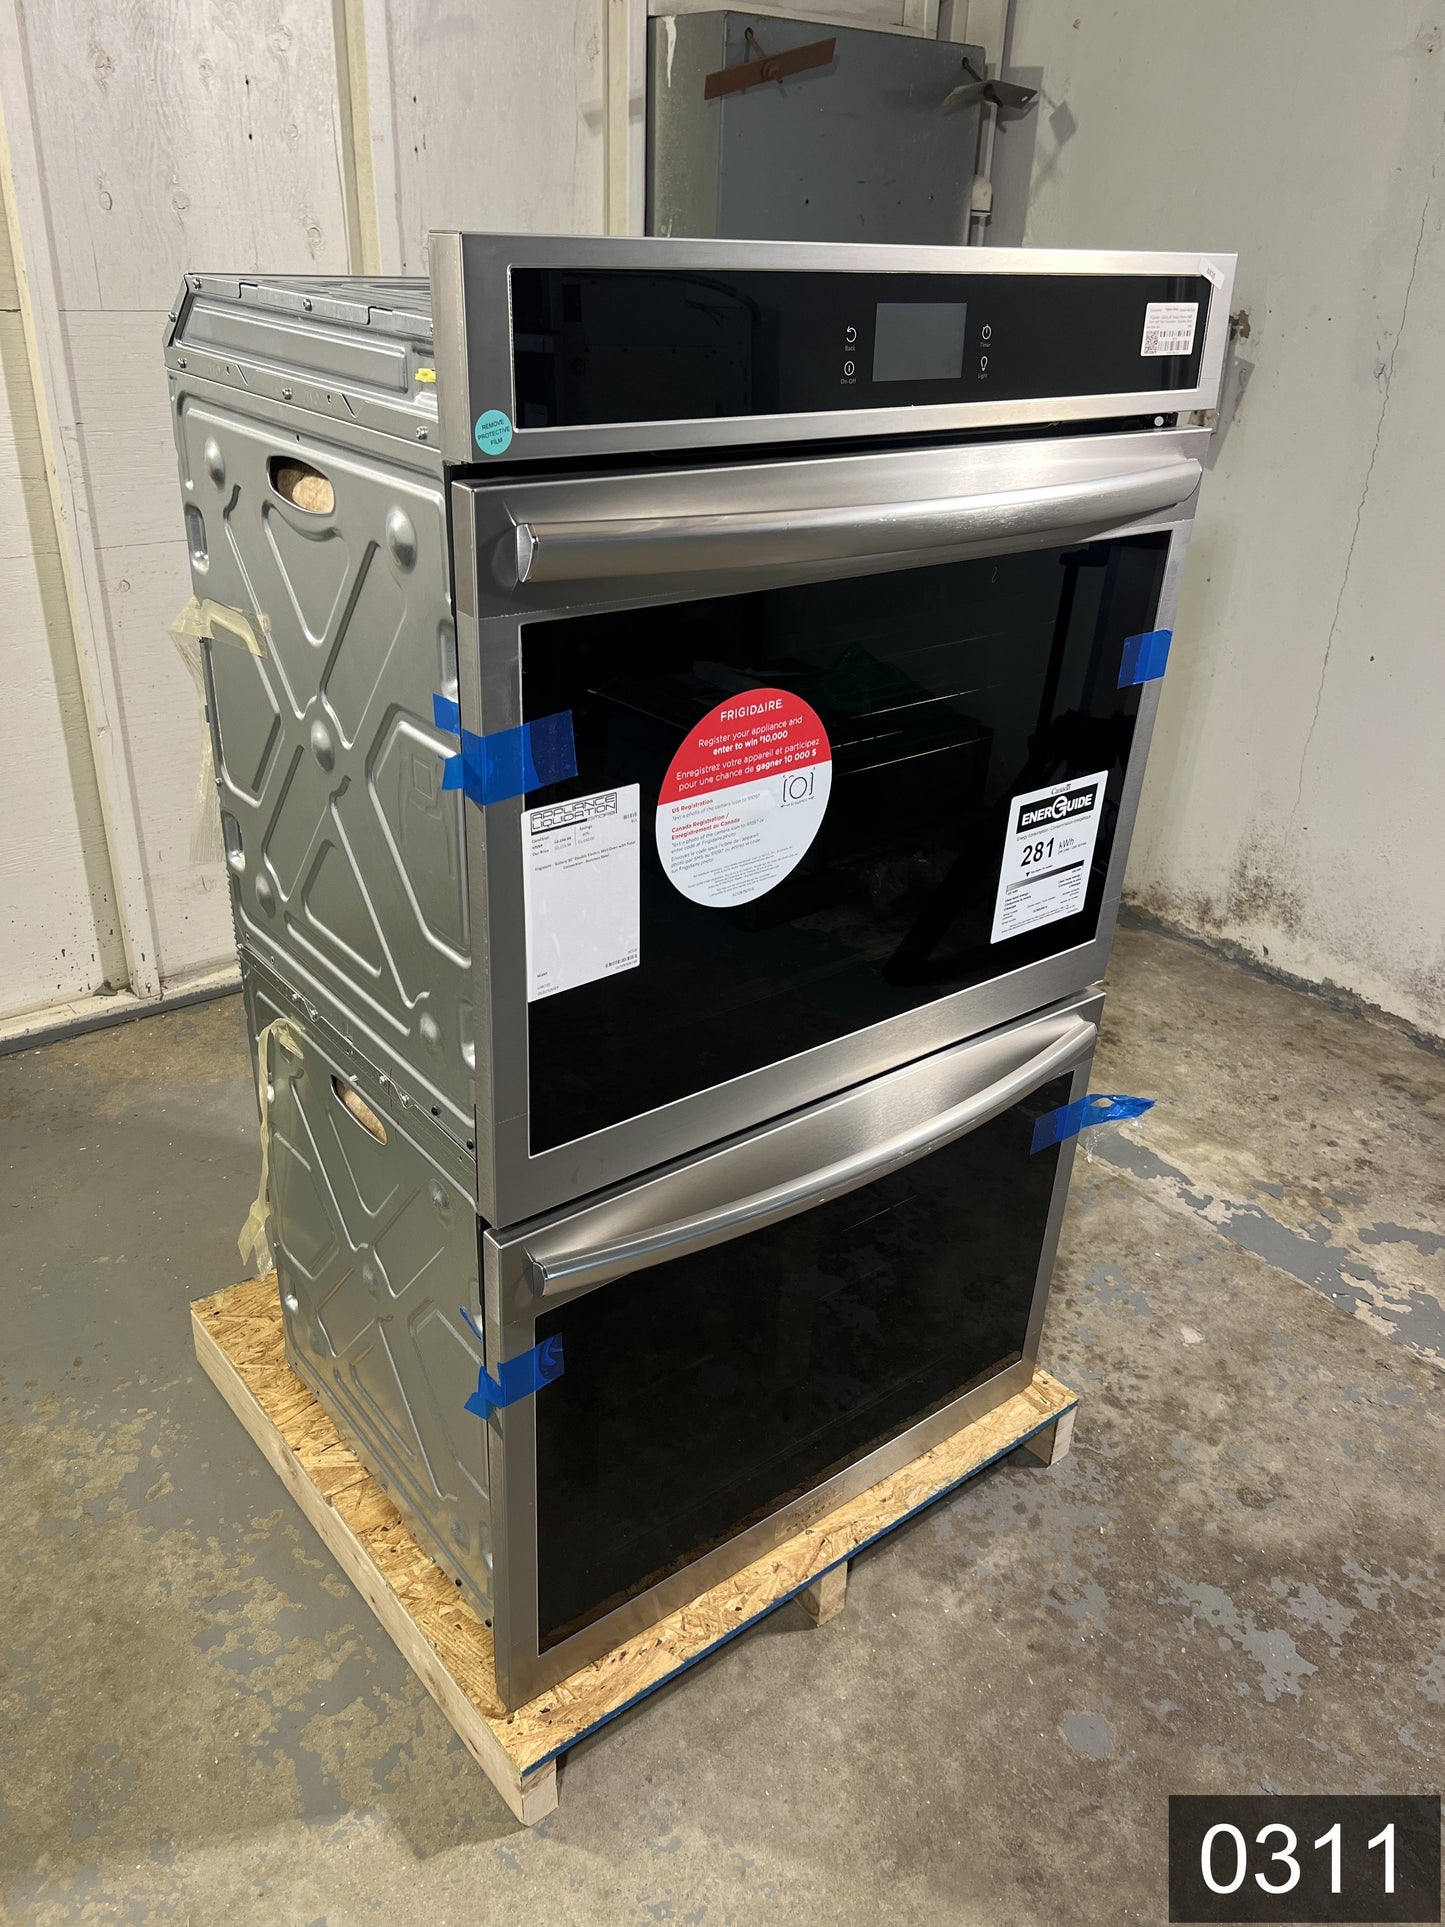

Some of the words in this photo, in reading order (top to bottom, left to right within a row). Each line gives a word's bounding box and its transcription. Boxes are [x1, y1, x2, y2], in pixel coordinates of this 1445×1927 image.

[478, 426, 510, 440] PROTECTIVE
[482, 419, 504, 430] REMOVE
[490, 437, 503, 446] FILM
[720, 698, 784, 722] FRIGIDAIRE
[698, 734, 731, 748] Register
[732, 729, 750, 742] your
[752, 720, 787, 736] appliance
[788, 715, 803, 726] and
[712, 744, 734, 756] enter
[735, 742, 744, 750] to
[744, 738, 758, 748] win
[760, 730, 788, 744] $10,000
[676, 763, 721, 781] Enregistrez
[722, 758, 742, 768] votre
[744, 748, 774, 764] appareil
[775, 747, 783, 755] et
[784, 738, 820, 754] participez
[678, 780, 698, 792] pour
[700, 776, 714, 786] une
[716, 767, 743, 782] chance
[744, 766, 754, 774] de
[756, 758, 783, 773] gagner
[784, 755, 793, 764] 10
[794, 750, 810, 761] 000
[811, 748, 817, 757] $
[532, 793, 615, 821] APPLIANCE
[532, 802, 616, 830] LIQUIDATION
[680, 798, 714, 812] Registration
[1021, 794, 1093, 826] ENERGUIDE
[672, 822, 692, 833] Canada
[692, 814, 725, 828] Registration
[672, 826, 712, 840] Enregistrement
[720, 818, 740, 827] Canada
[1020, 837, 1054, 868] 281
[1058, 838, 1074, 849] kWh
